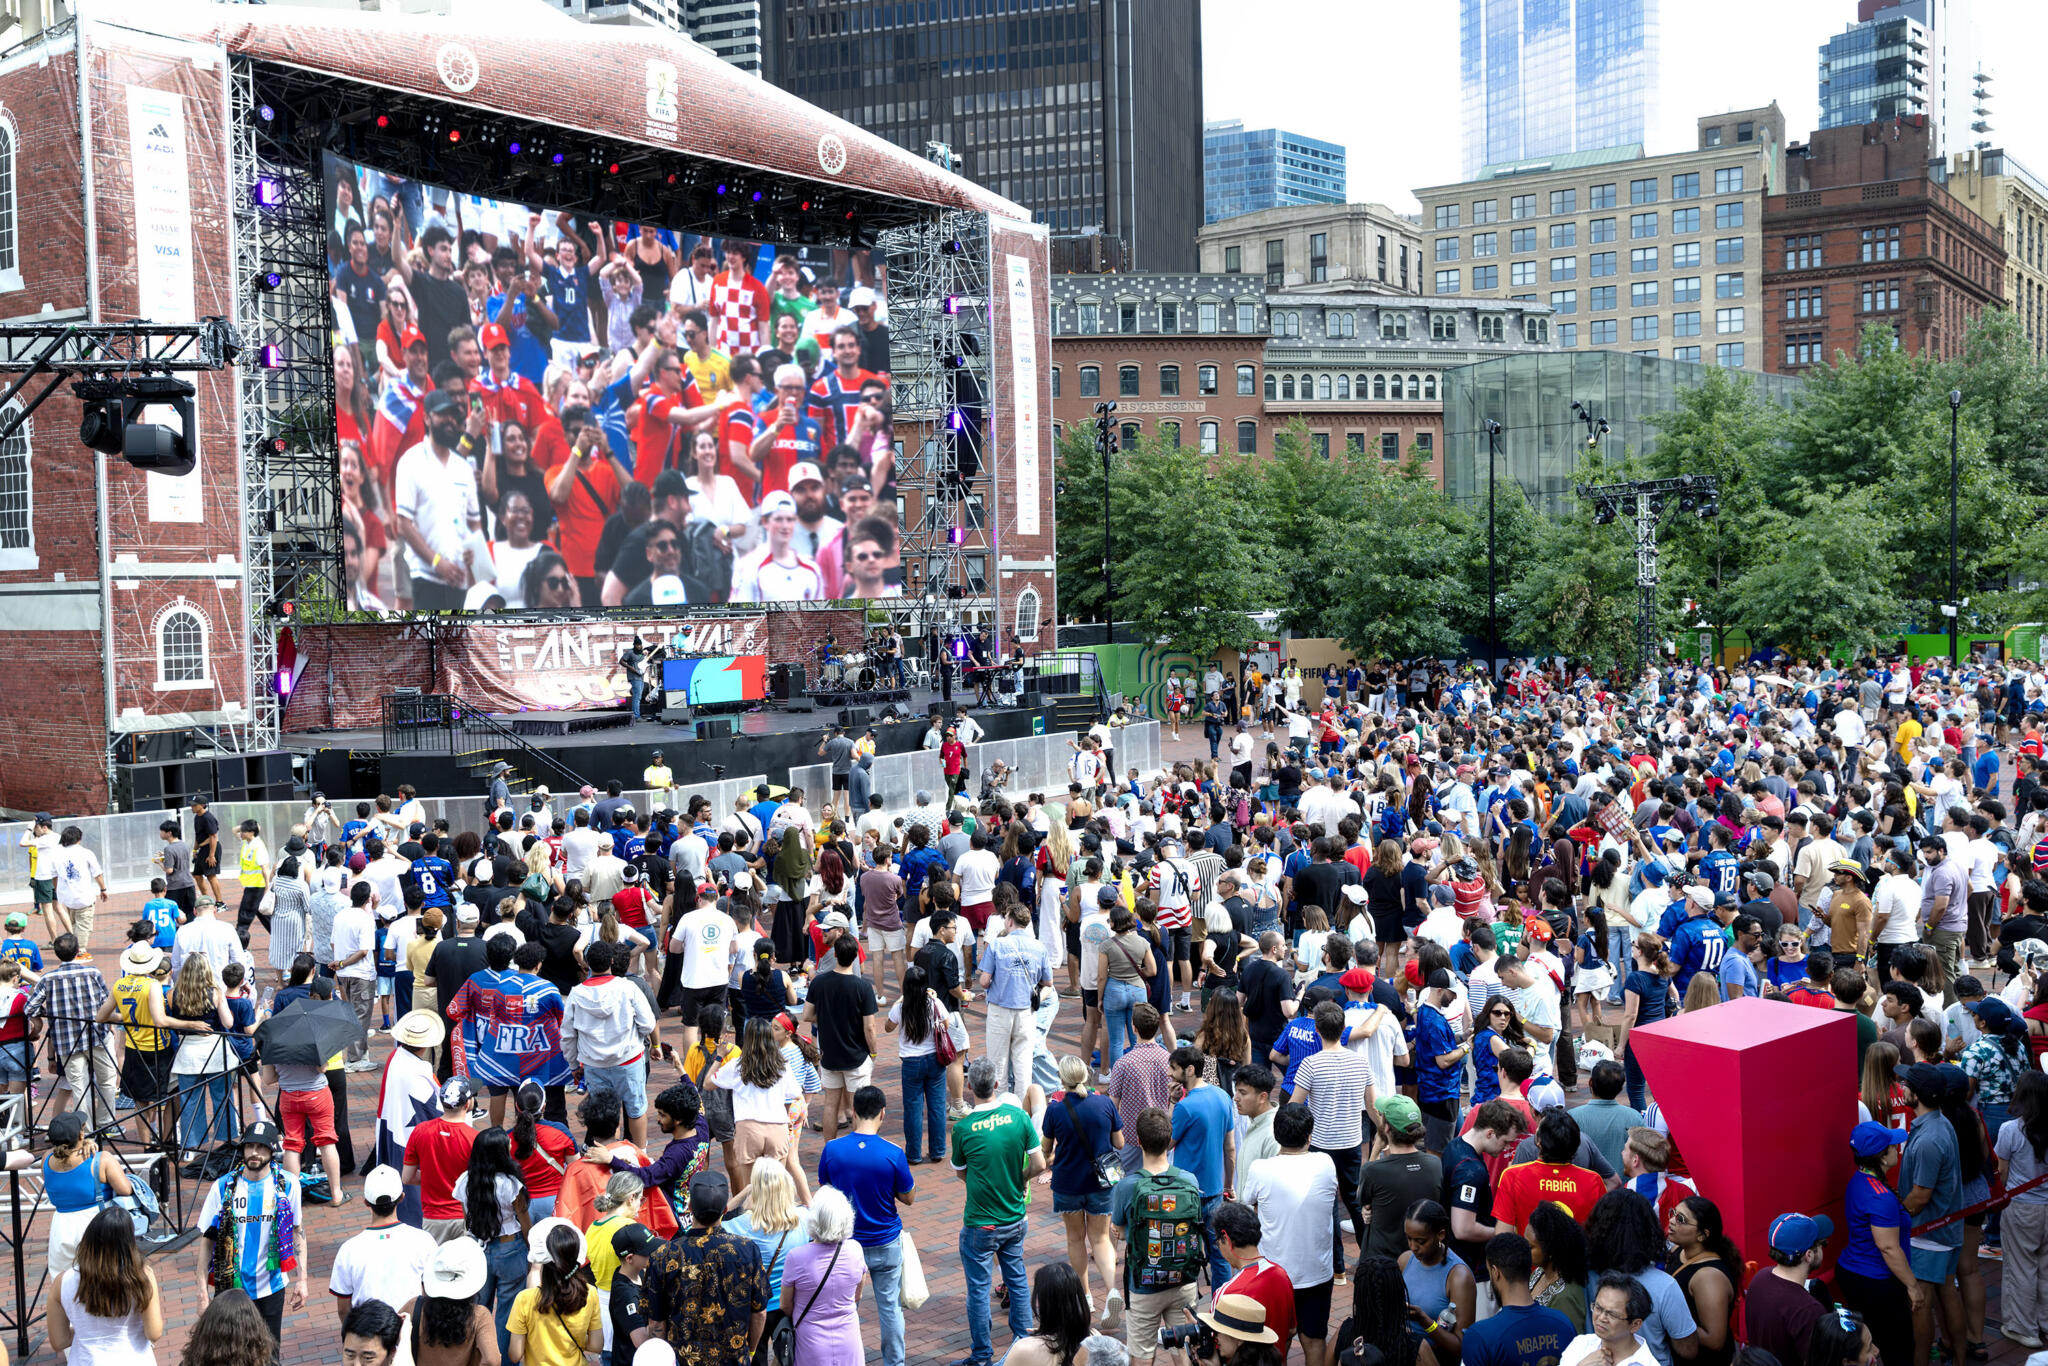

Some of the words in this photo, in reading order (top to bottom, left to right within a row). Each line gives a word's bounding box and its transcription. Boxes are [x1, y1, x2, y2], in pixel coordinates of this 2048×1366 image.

[656, 107, 670, 117] FIFA
[646, 127, 678, 142] 2026
[154, 244, 181, 257] VISA
[565, 287, 575, 304] 10
[1140, 402, 1204, 412] CRESCENT
[773, 439, 815, 451] UROBET
[496, 627, 513, 671] FIFA
[511, 627, 590, 671] FAN
[590, 623, 743, 667] FESTVAL
[629, 844, 645, 854] ZIDA
[421, 872, 437, 895] 8
[1719, 866, 1738, 892] 18
[148, 908, 170, 928] 45
[1701, 937, 1724, 970] 10
[122, 997, 138, 1032] 7
[495, 1023, 551, 1053] FRA
[1288, 1026, 1315, 1043] FRANCE
[970, 1113, 1012, 1132] crefisa
[1539, 1176, 1577, 1193] FABIÁN
[234, 1196, 247, 1209] 10
[1515, 1333, 1560, 1356] MBAPPE
